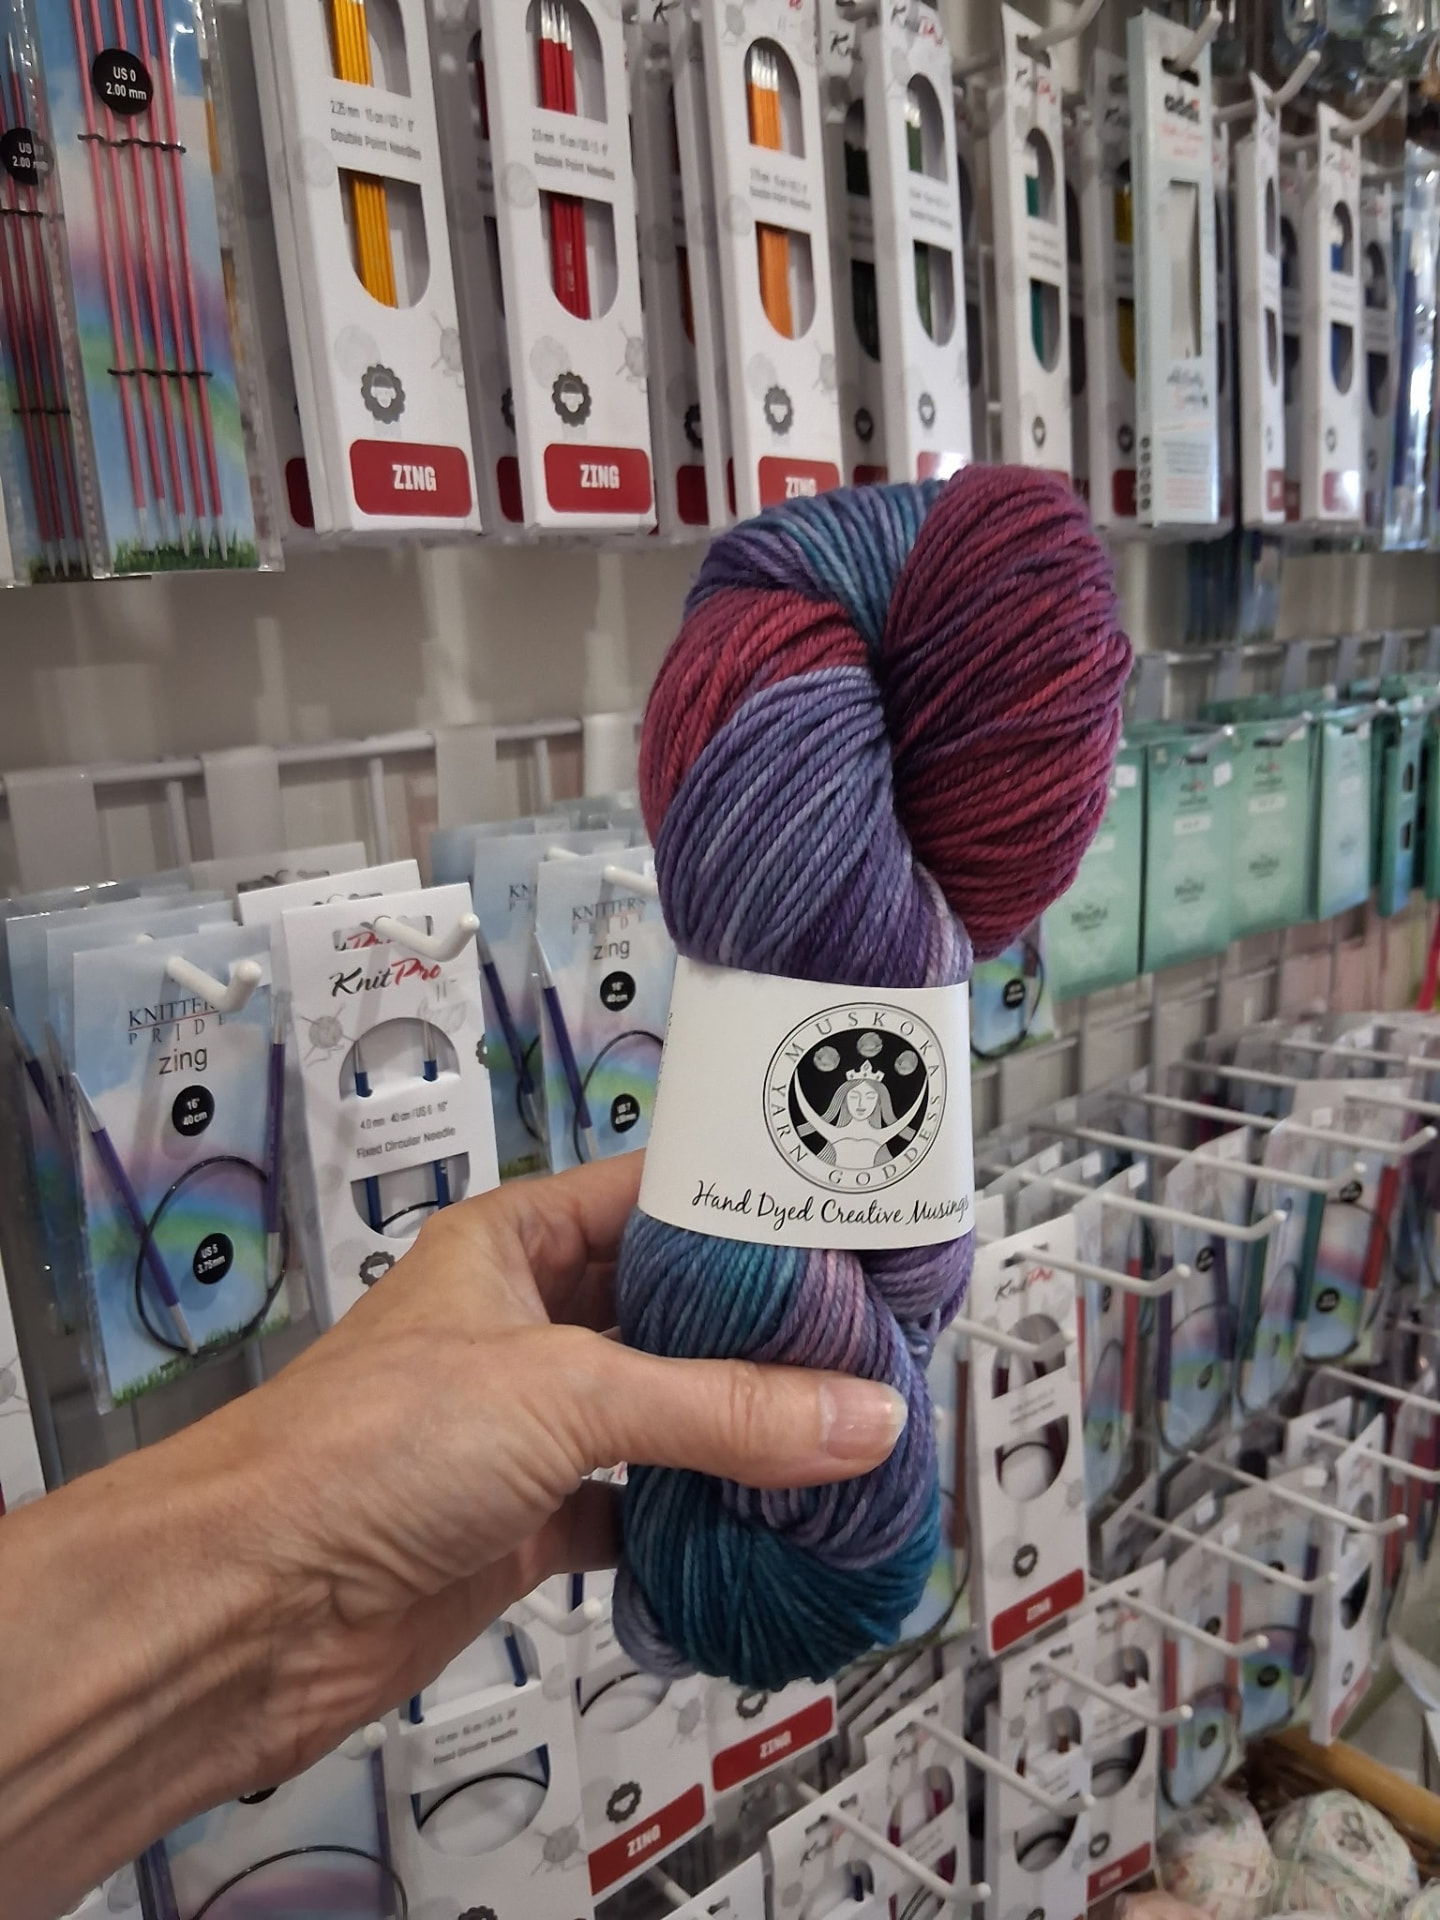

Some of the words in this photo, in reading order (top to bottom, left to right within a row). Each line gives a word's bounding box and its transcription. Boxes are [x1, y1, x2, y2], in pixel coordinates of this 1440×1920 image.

[112, 65, 128, 81] US
[130, 69, 137, 82] 0
[105, 82, 127, 97] 2.00
[128, 87, 147, 100] mm
[12, 156, 31, 168] 2.00
[18, 142, 32, 154] US
[392, 464, 437, 492] ZING
[579, 464, 620, 489] ZING
[785, 1011, 940, 1077] MUSKOKA
[158, 1047, 208, 1076] zing
[771, 1084, 809, 1163] YARN
[356, 1144, 383, 1159] Fixed
[423, 1127, 456, 1143] Needle
[828, 1095, 941, 1187] GODDESS
[691, 1179, 752, 1216] Hand
[757, 1191, 814, 1231] Dyed
[820, 1198, 903, 1225] Creative
[200, 1246, 213, 1259] US
